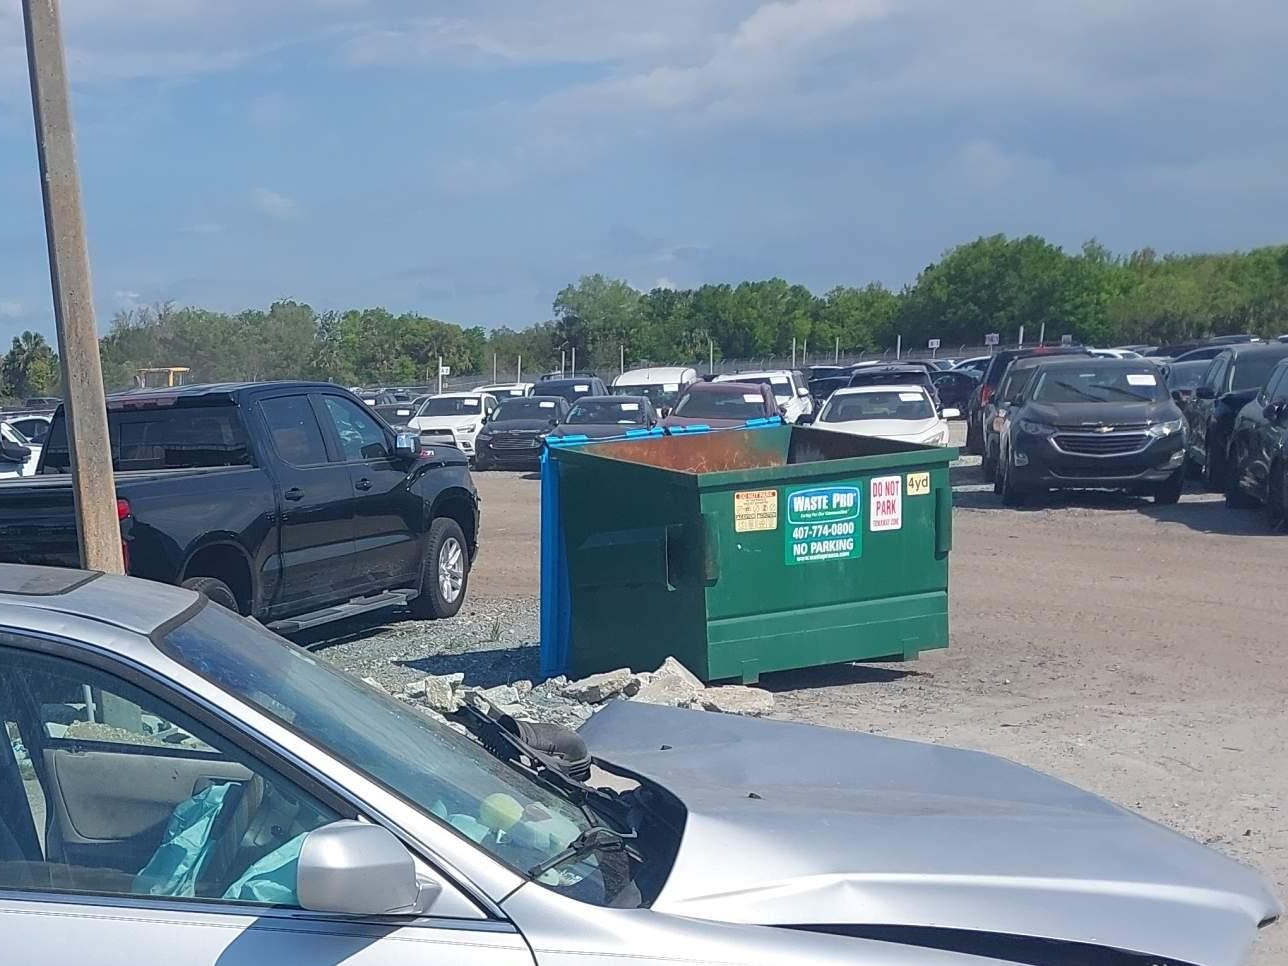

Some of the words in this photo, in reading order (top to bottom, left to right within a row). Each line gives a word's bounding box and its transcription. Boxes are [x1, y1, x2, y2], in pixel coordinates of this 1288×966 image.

[872, 481, 883, 498] DO
[885, 480, 900, 497] NOT
[908, 475, 929, 492] 4yd
[876, 499, 897, 516] PARK
[792, 521, 855, 540] 407-774-0800
[793, 543, 808, 556] NO
[811, 538, 854, 554] PARKING
